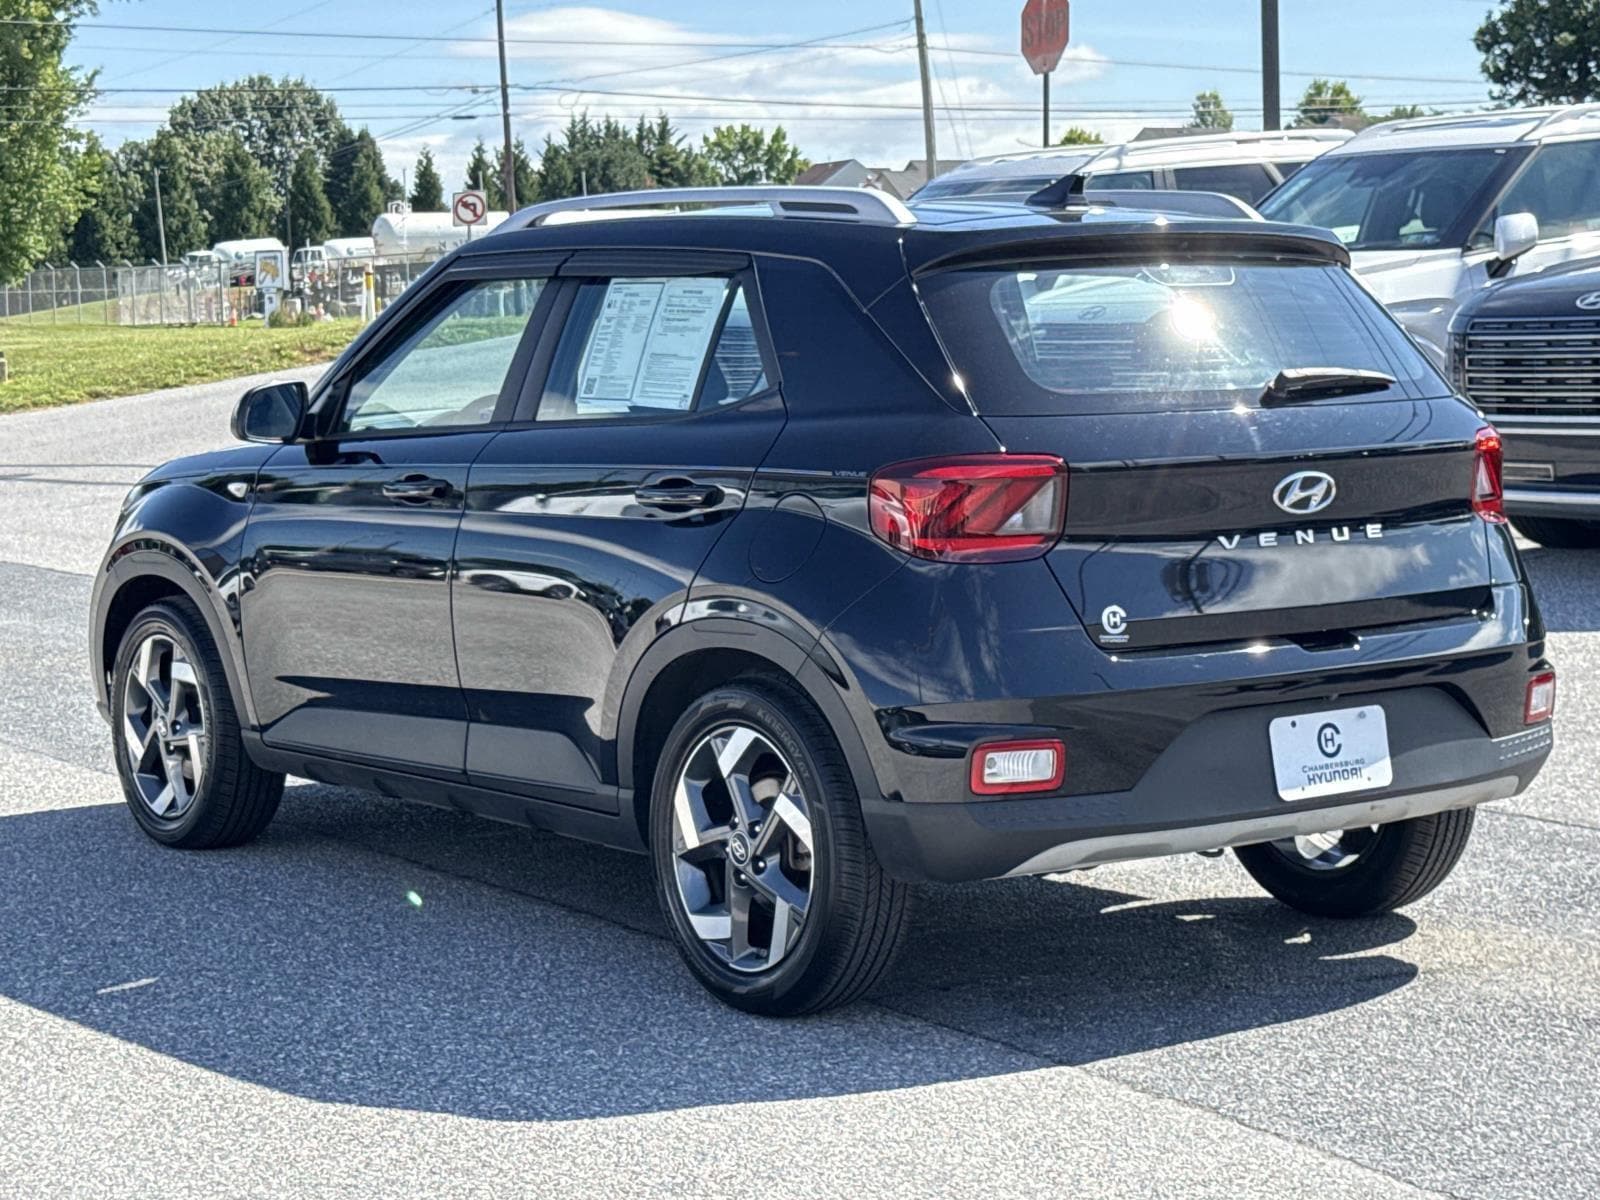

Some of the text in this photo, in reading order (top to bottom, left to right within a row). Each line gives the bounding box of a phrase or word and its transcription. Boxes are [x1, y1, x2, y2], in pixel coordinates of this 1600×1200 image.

[1024, 7, 1067, 48] STOP
[1217, 523, 1383, 549] VENUE
[1307, 766, 1364, 786] HYUNDAI
